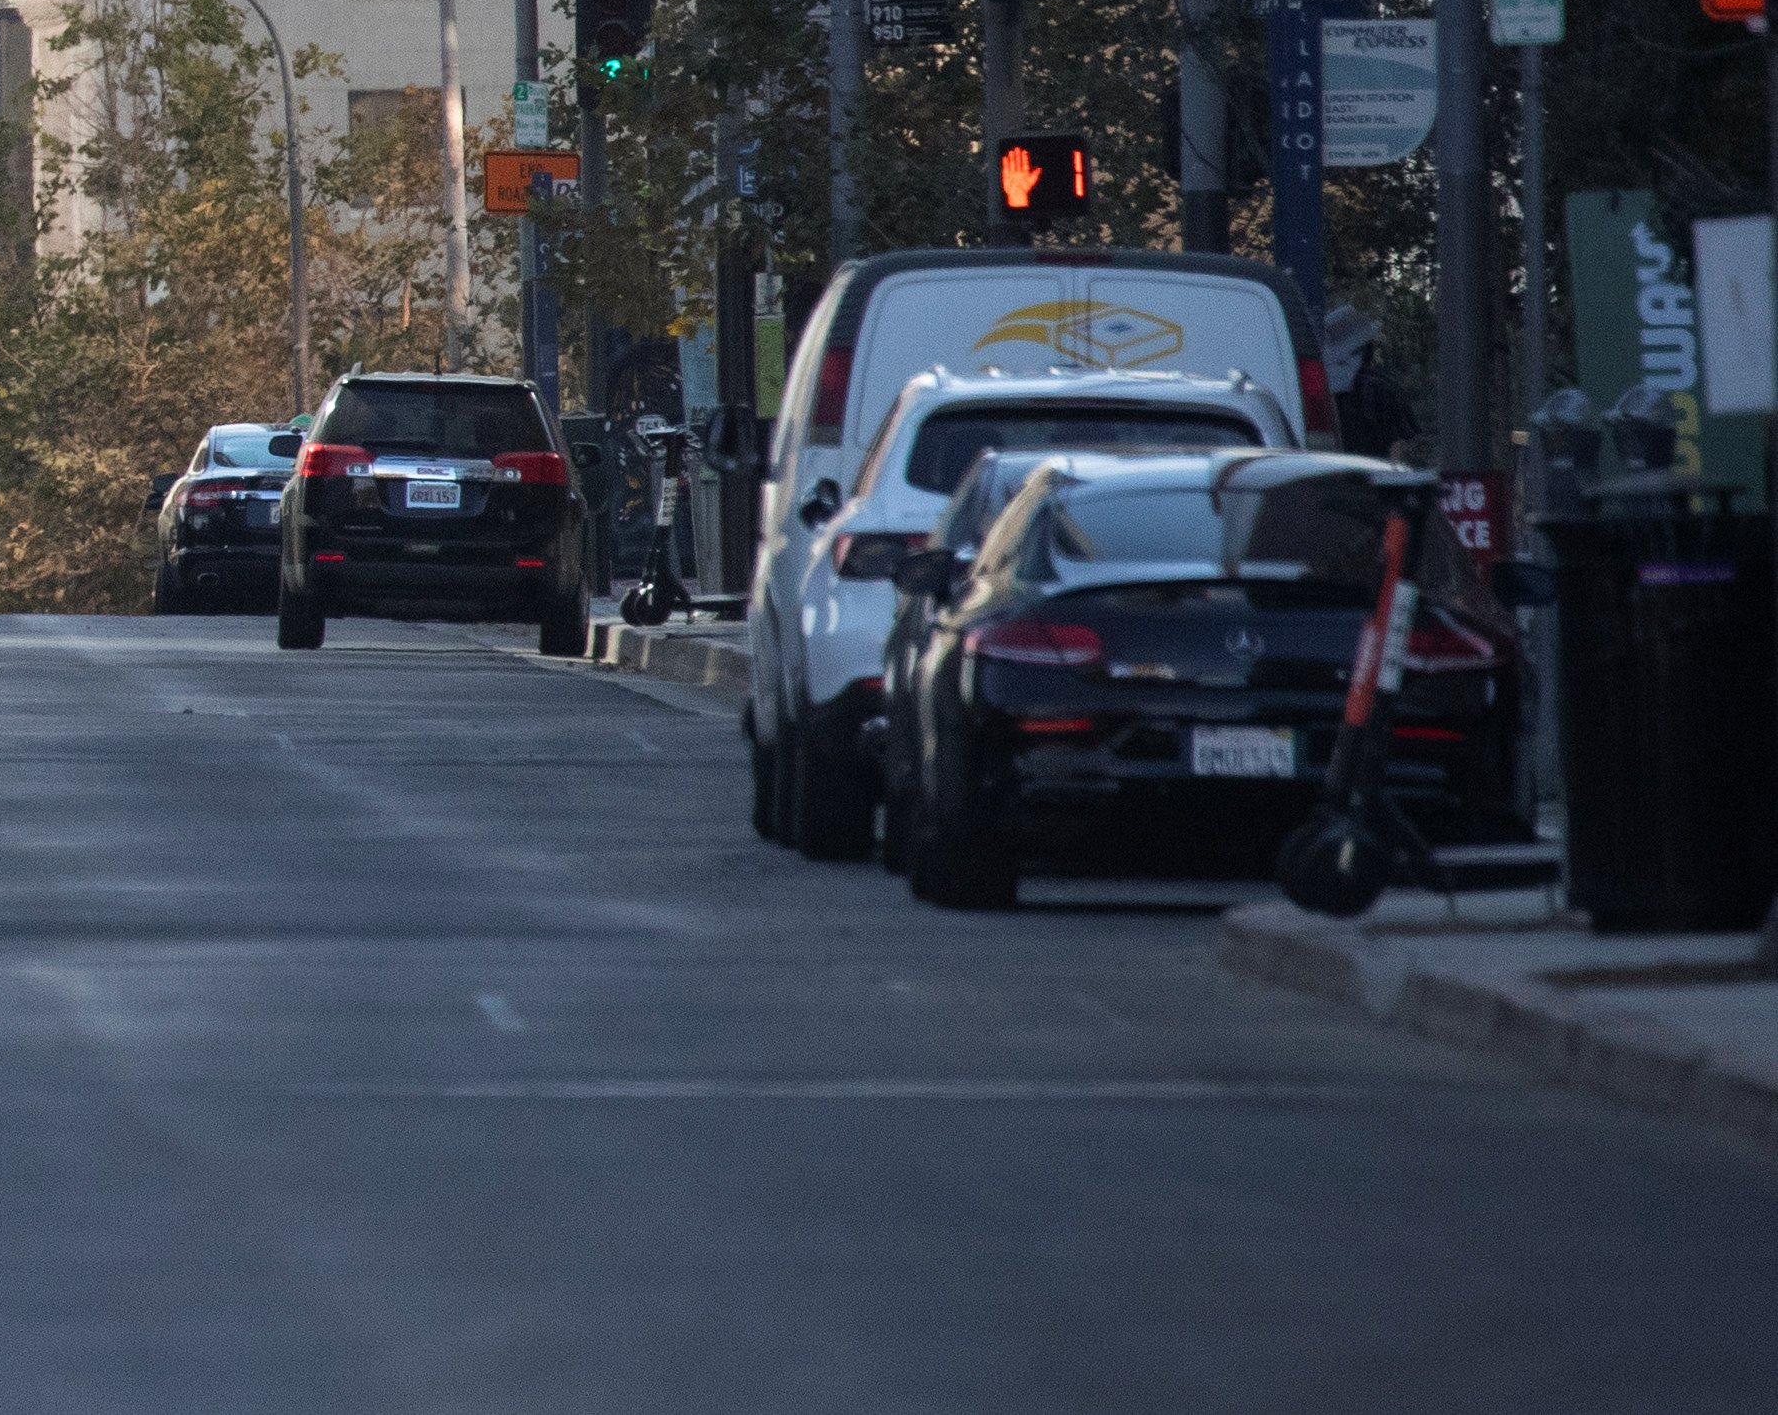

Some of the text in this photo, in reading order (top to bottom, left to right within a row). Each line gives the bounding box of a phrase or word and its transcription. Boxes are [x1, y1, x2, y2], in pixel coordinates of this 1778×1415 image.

[872, 5, 903, 22] 910
[873, 24, 904, 41] 950
[1325, 25, 1408, 37] COMMUTER
[517, 85, 525, 99] 2
[1324, 93, 1416, 103] UNION STATION
[1325, 115, 1398, 124] BUNKER HILL
[497, 187, 529, 203] ROA
